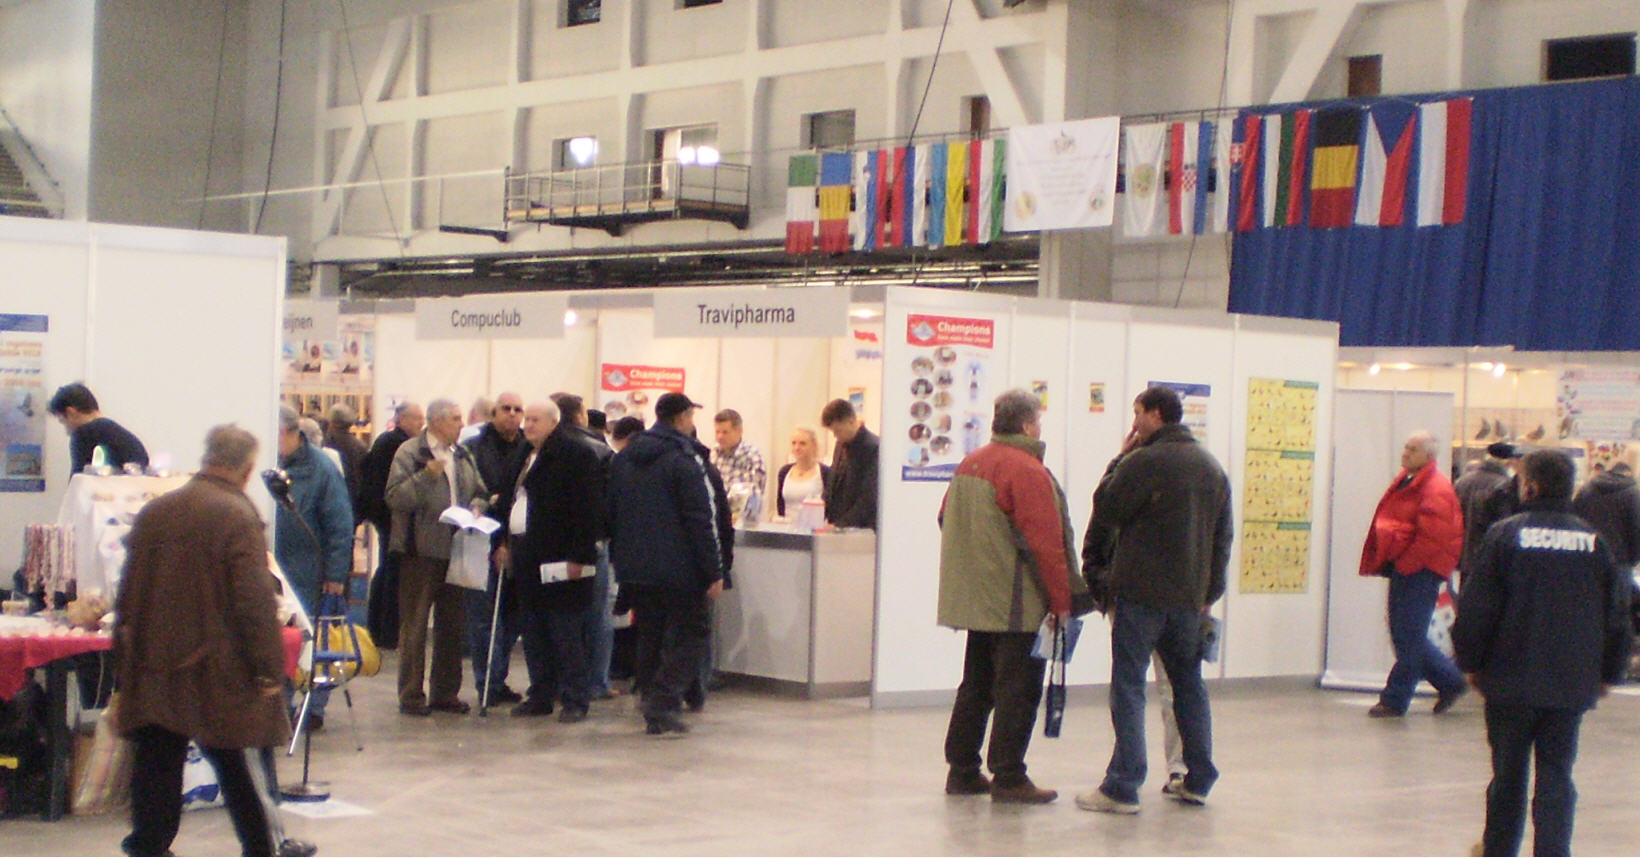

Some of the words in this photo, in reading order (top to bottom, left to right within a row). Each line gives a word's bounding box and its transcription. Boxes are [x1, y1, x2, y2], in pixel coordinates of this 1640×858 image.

[451, 309, 521, 331] Compuclub
[697, 303, 795, 329] Travipharma
[937, 321, 991, 336] Champions
[630, 369, 683, 382] Champions
[1519, 527, 1597, 553] SECURITY
